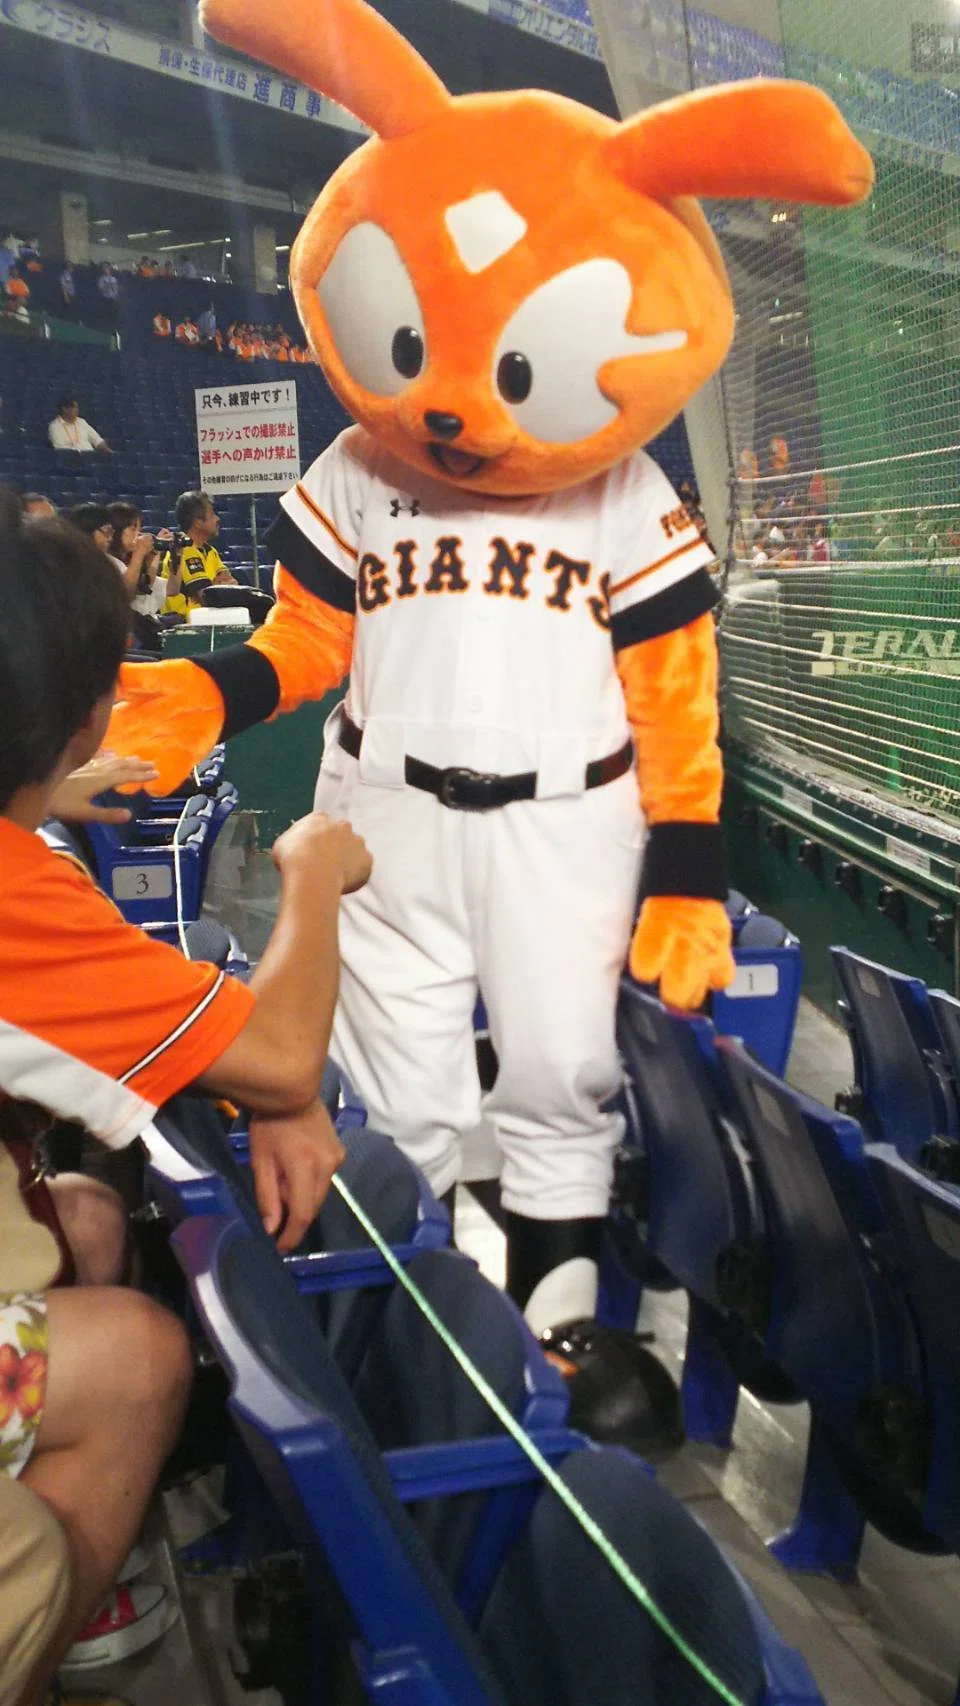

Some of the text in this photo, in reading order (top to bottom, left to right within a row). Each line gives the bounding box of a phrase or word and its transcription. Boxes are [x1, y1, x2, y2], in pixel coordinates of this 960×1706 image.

[202, 388, 290, 409] 只今、練習中です！
[200, 422, 296, 443] フラッシュでの撮影禁止
[201, 445, 297, 465] 選手への声かけ禁止
[136, 872, 150, 895] 3
[748, 973, 755, 991] 1
